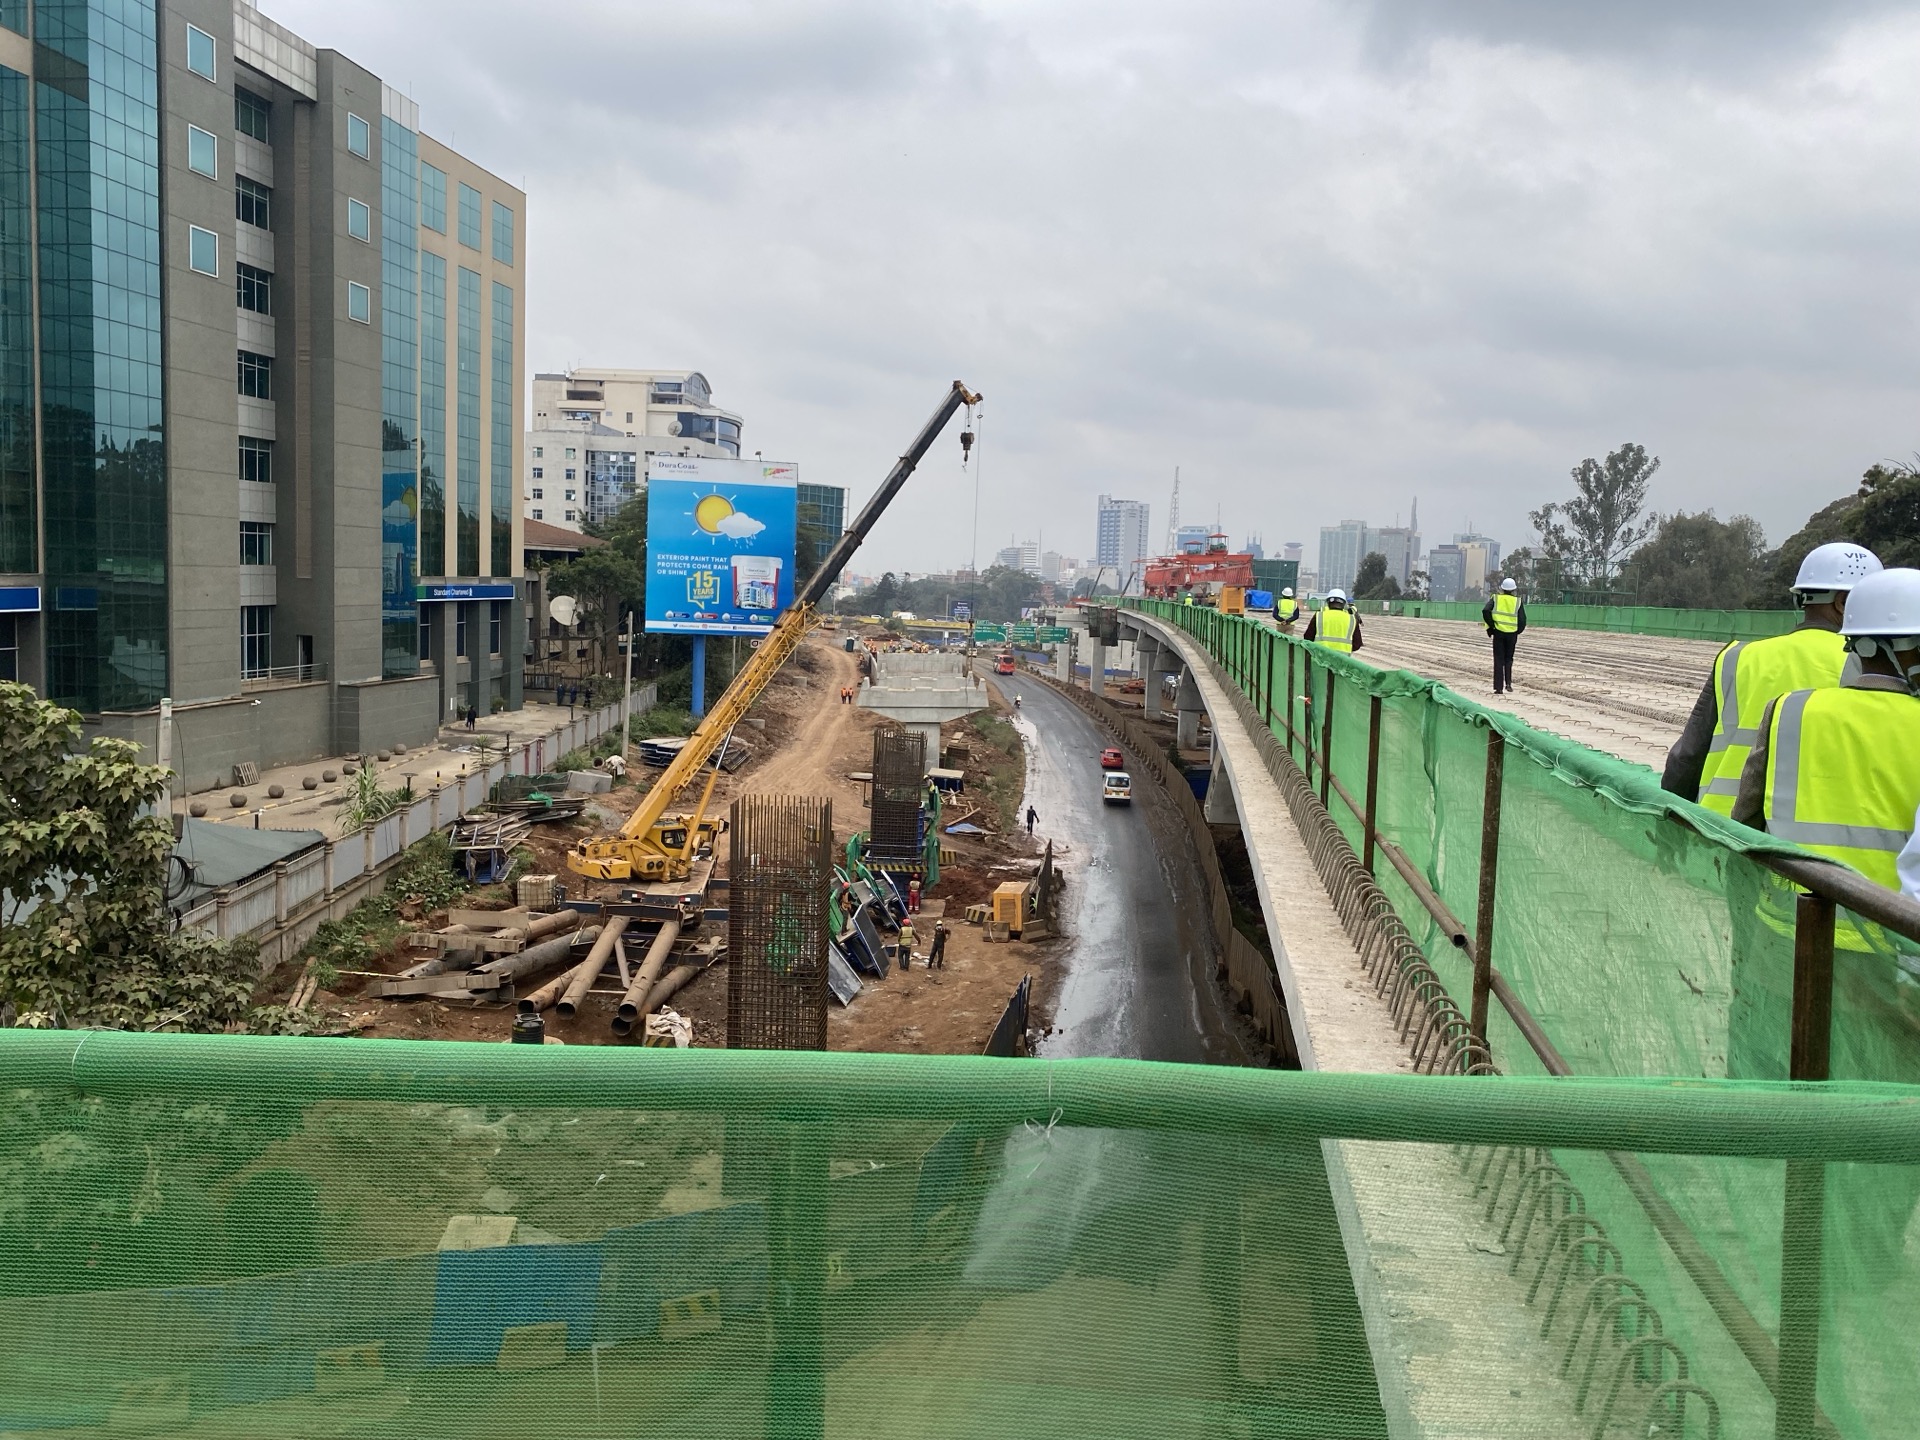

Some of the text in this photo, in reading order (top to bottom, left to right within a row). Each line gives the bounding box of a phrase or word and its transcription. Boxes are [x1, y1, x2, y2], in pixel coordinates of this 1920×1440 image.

[657, 561, 691, 569] PROTECTS
[693, 570, 713, 588] 15
[434, 588, 451, 596] Standard
